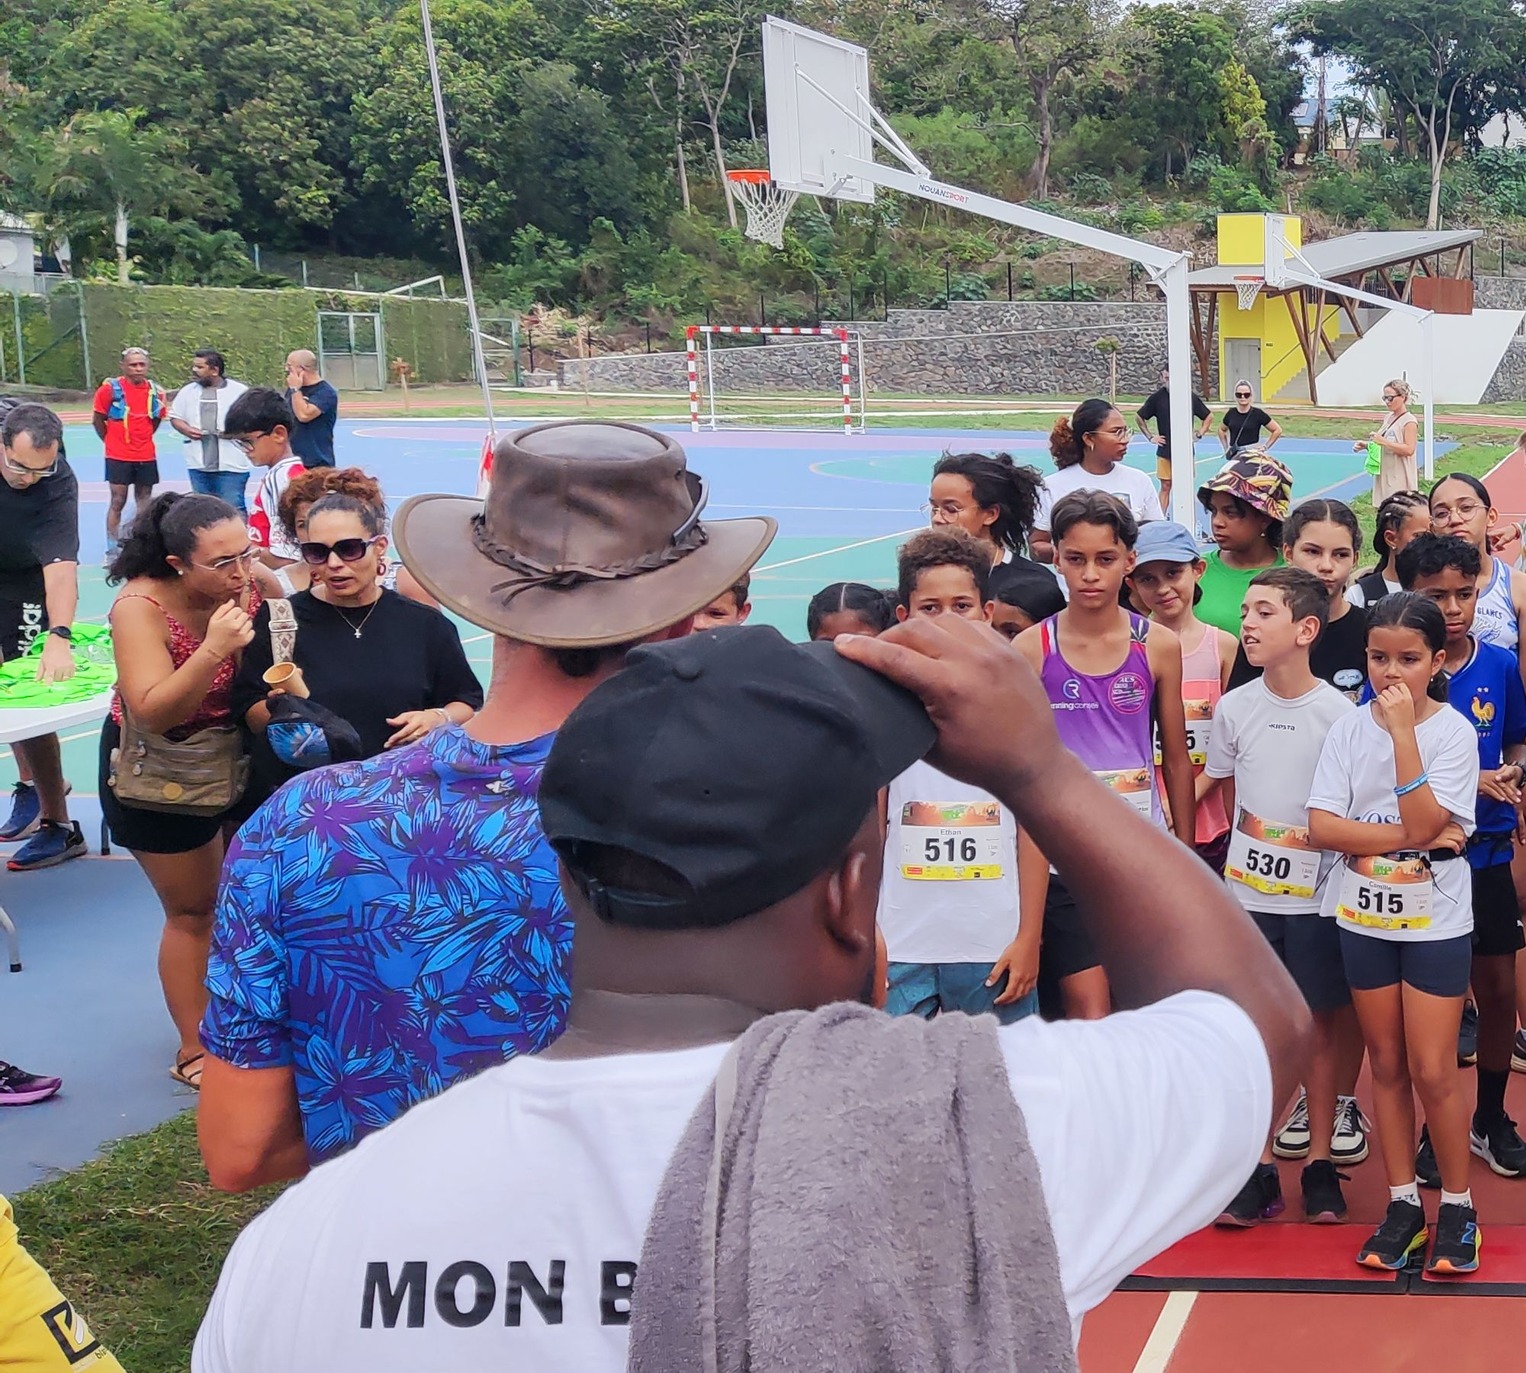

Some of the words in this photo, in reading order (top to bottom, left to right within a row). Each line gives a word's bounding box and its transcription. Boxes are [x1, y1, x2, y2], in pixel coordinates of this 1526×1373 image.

[919, 184, 969, 203] NOUANSPORT
[1155, 730, 1196, 751] 55
[924, 838, 977, 862] 516
[1246, 848, 1291, 880] 530
[1368, 881, 1392, 892] Camille
[1358, 886, 1403, 914] 515
[360, 1260, 566, 1328] MON
[600, 1261, 638, 1325] B
